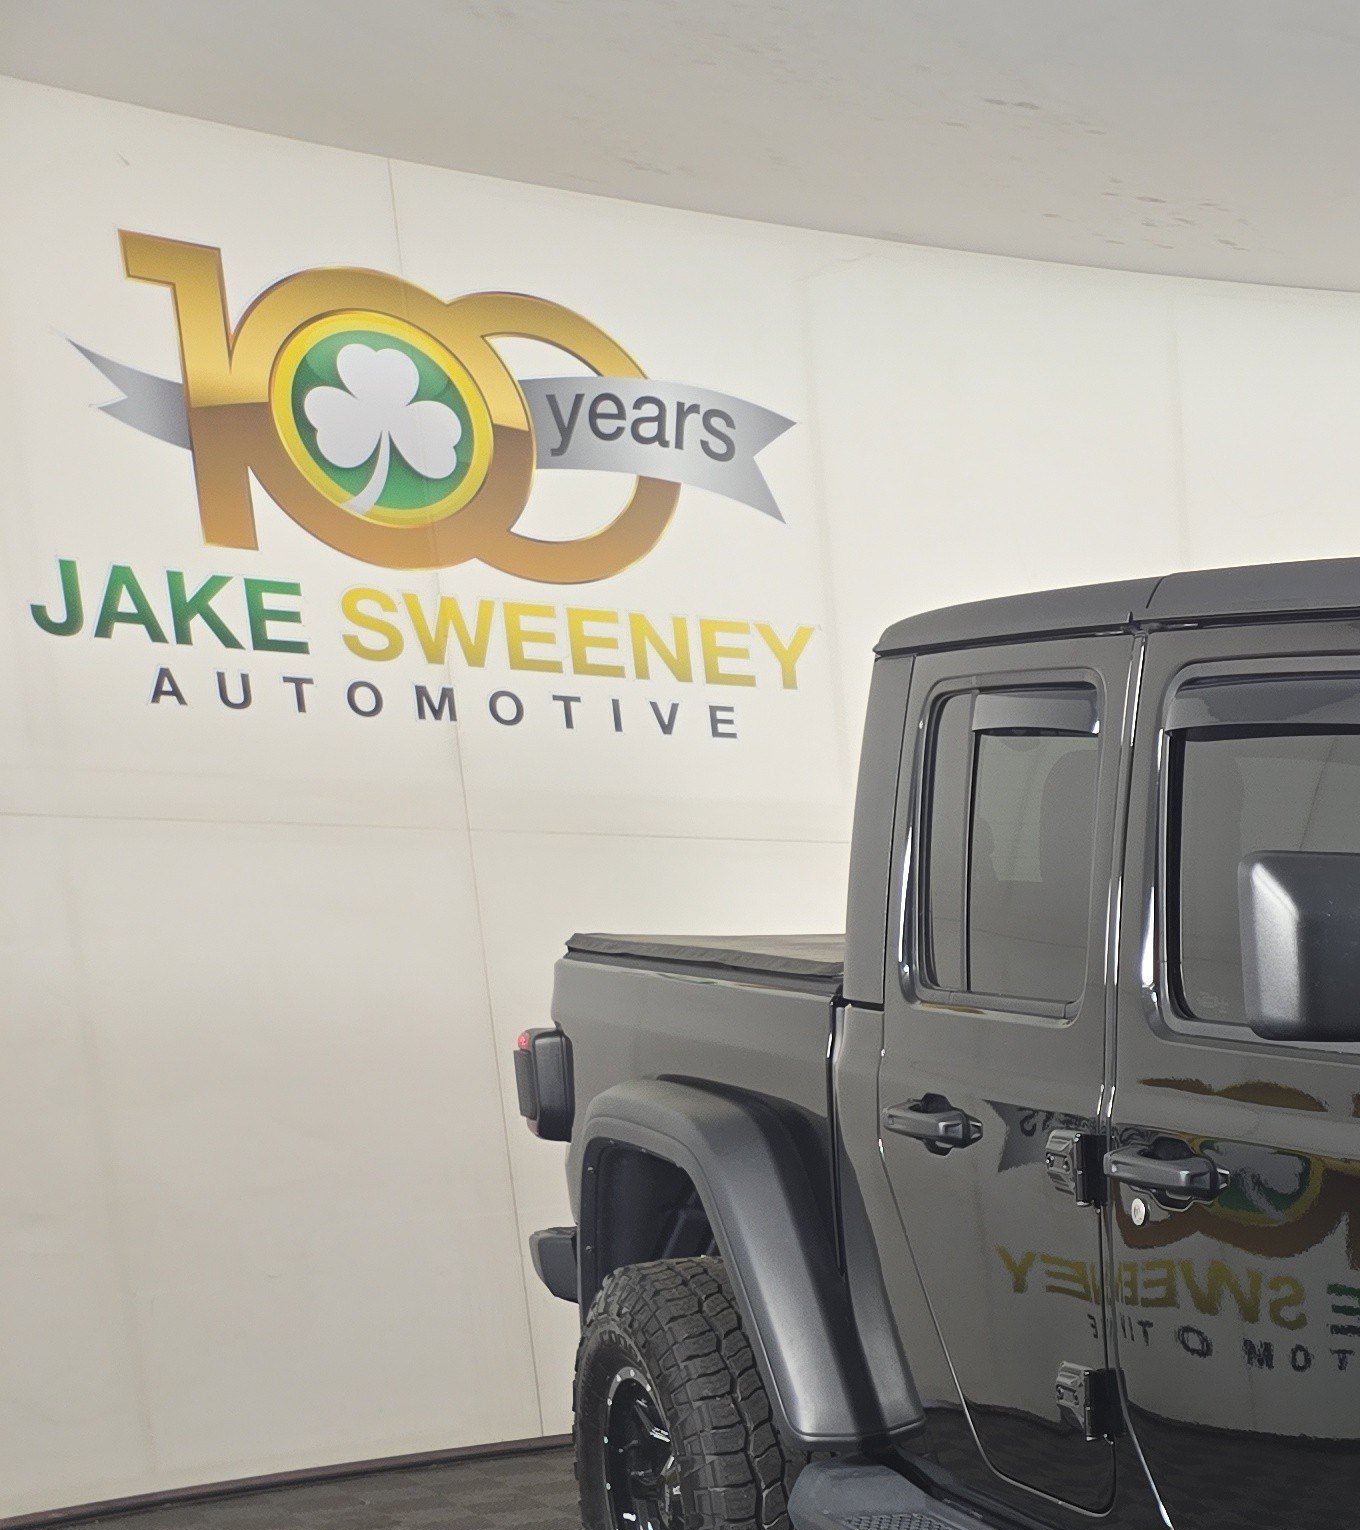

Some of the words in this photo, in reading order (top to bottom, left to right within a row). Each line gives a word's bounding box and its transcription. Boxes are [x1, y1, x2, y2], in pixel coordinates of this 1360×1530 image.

[116, 228, 682, 586] 100
[544, 391, 738, 463] years
[30, 556, 311, 656] JAKE
[339, 586, 817, 691] SWEENEY
[150, 665, 738, 740] AUTOMOTIVE
